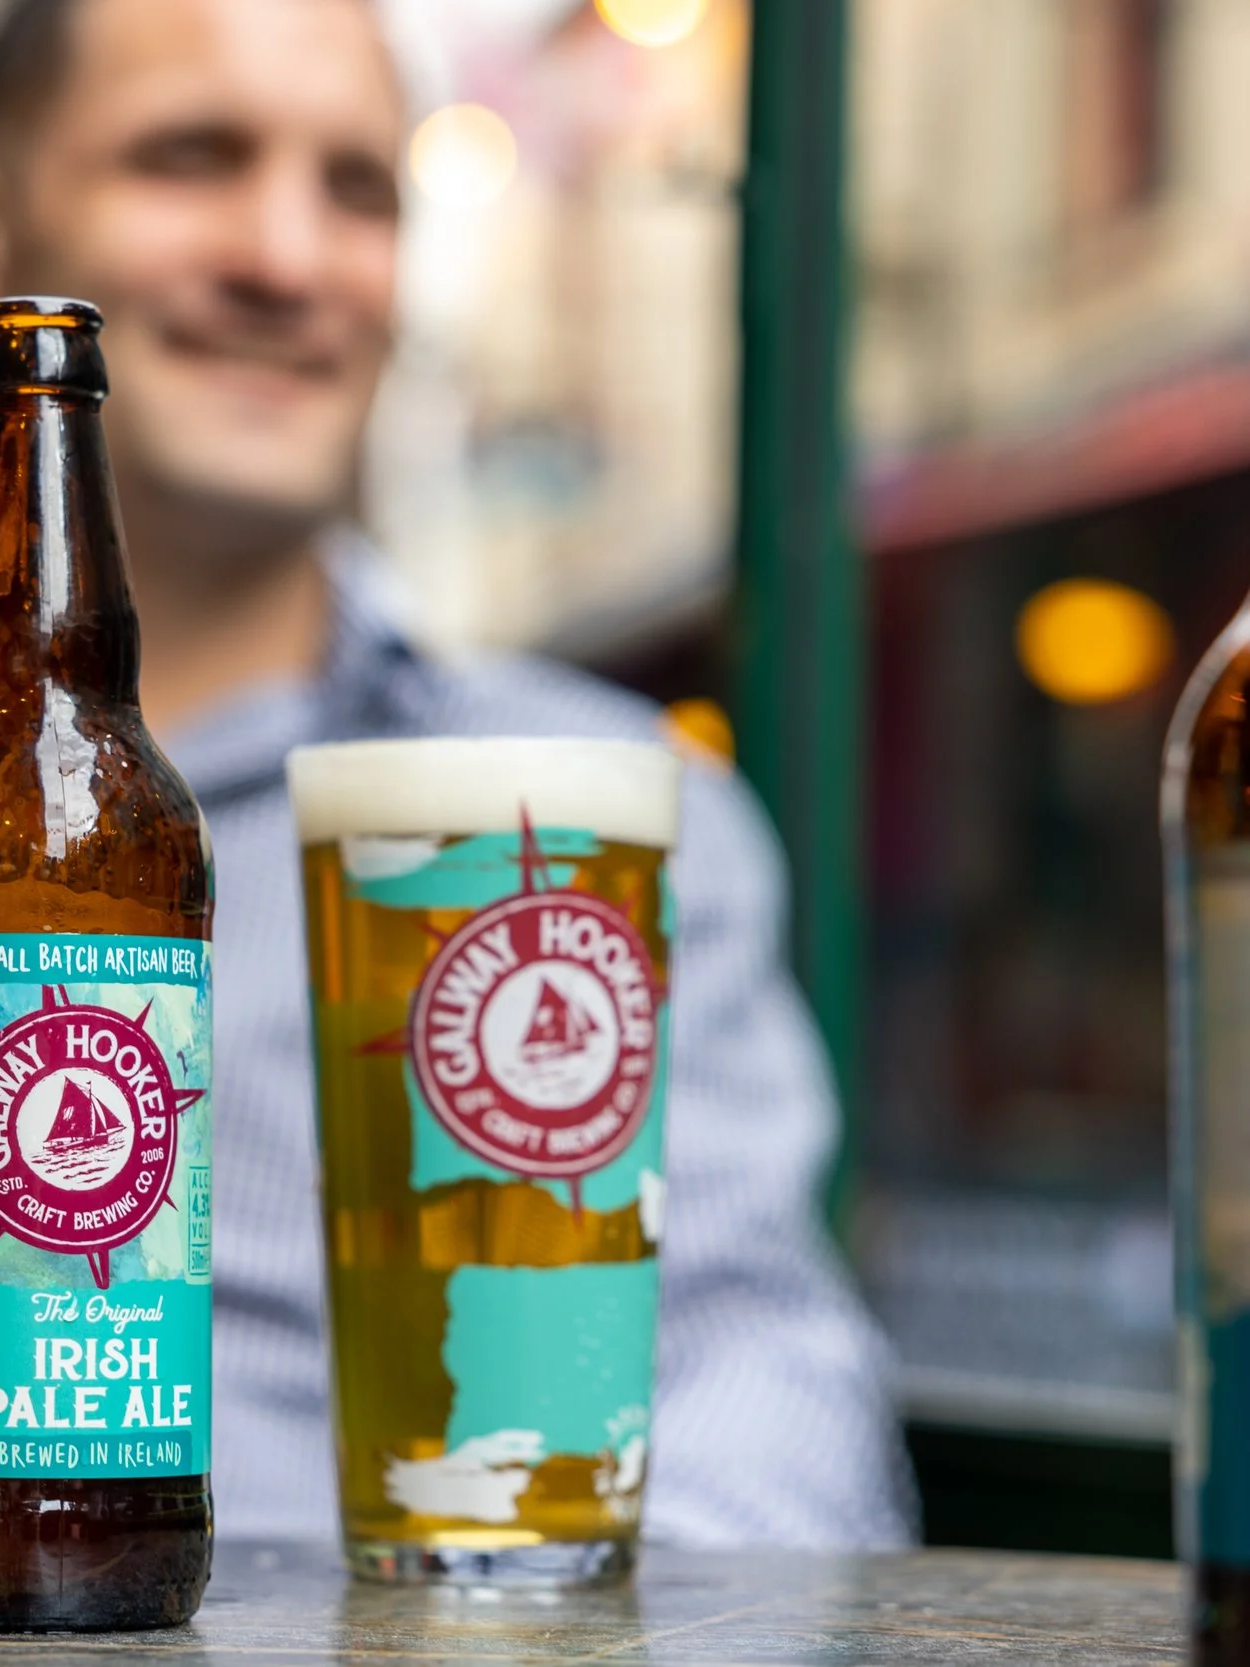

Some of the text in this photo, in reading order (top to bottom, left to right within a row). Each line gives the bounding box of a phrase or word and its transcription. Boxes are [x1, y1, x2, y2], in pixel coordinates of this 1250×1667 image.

[39, 943, 98, 975] BATCH
[105, 947, 168, 977] ARTISAN
[172, 947, 199, 979] BEER
[428, 923, 520, 1085] GALWAY
[66, 1024, 167, 1140] HOOKER
[141, 1146, 164, 1164] 2006
[18, 1170, 156, 1230] CRAFT BREWING CO.
[31, 1290, 164, 1335] The Original
[33, 1337, 159, 1381] IRISH
[120, 1384, 193, 1428] ALE
[90, 1441, 108, 1465] IN
[118, 1440, 182, 1469] IRELAND
